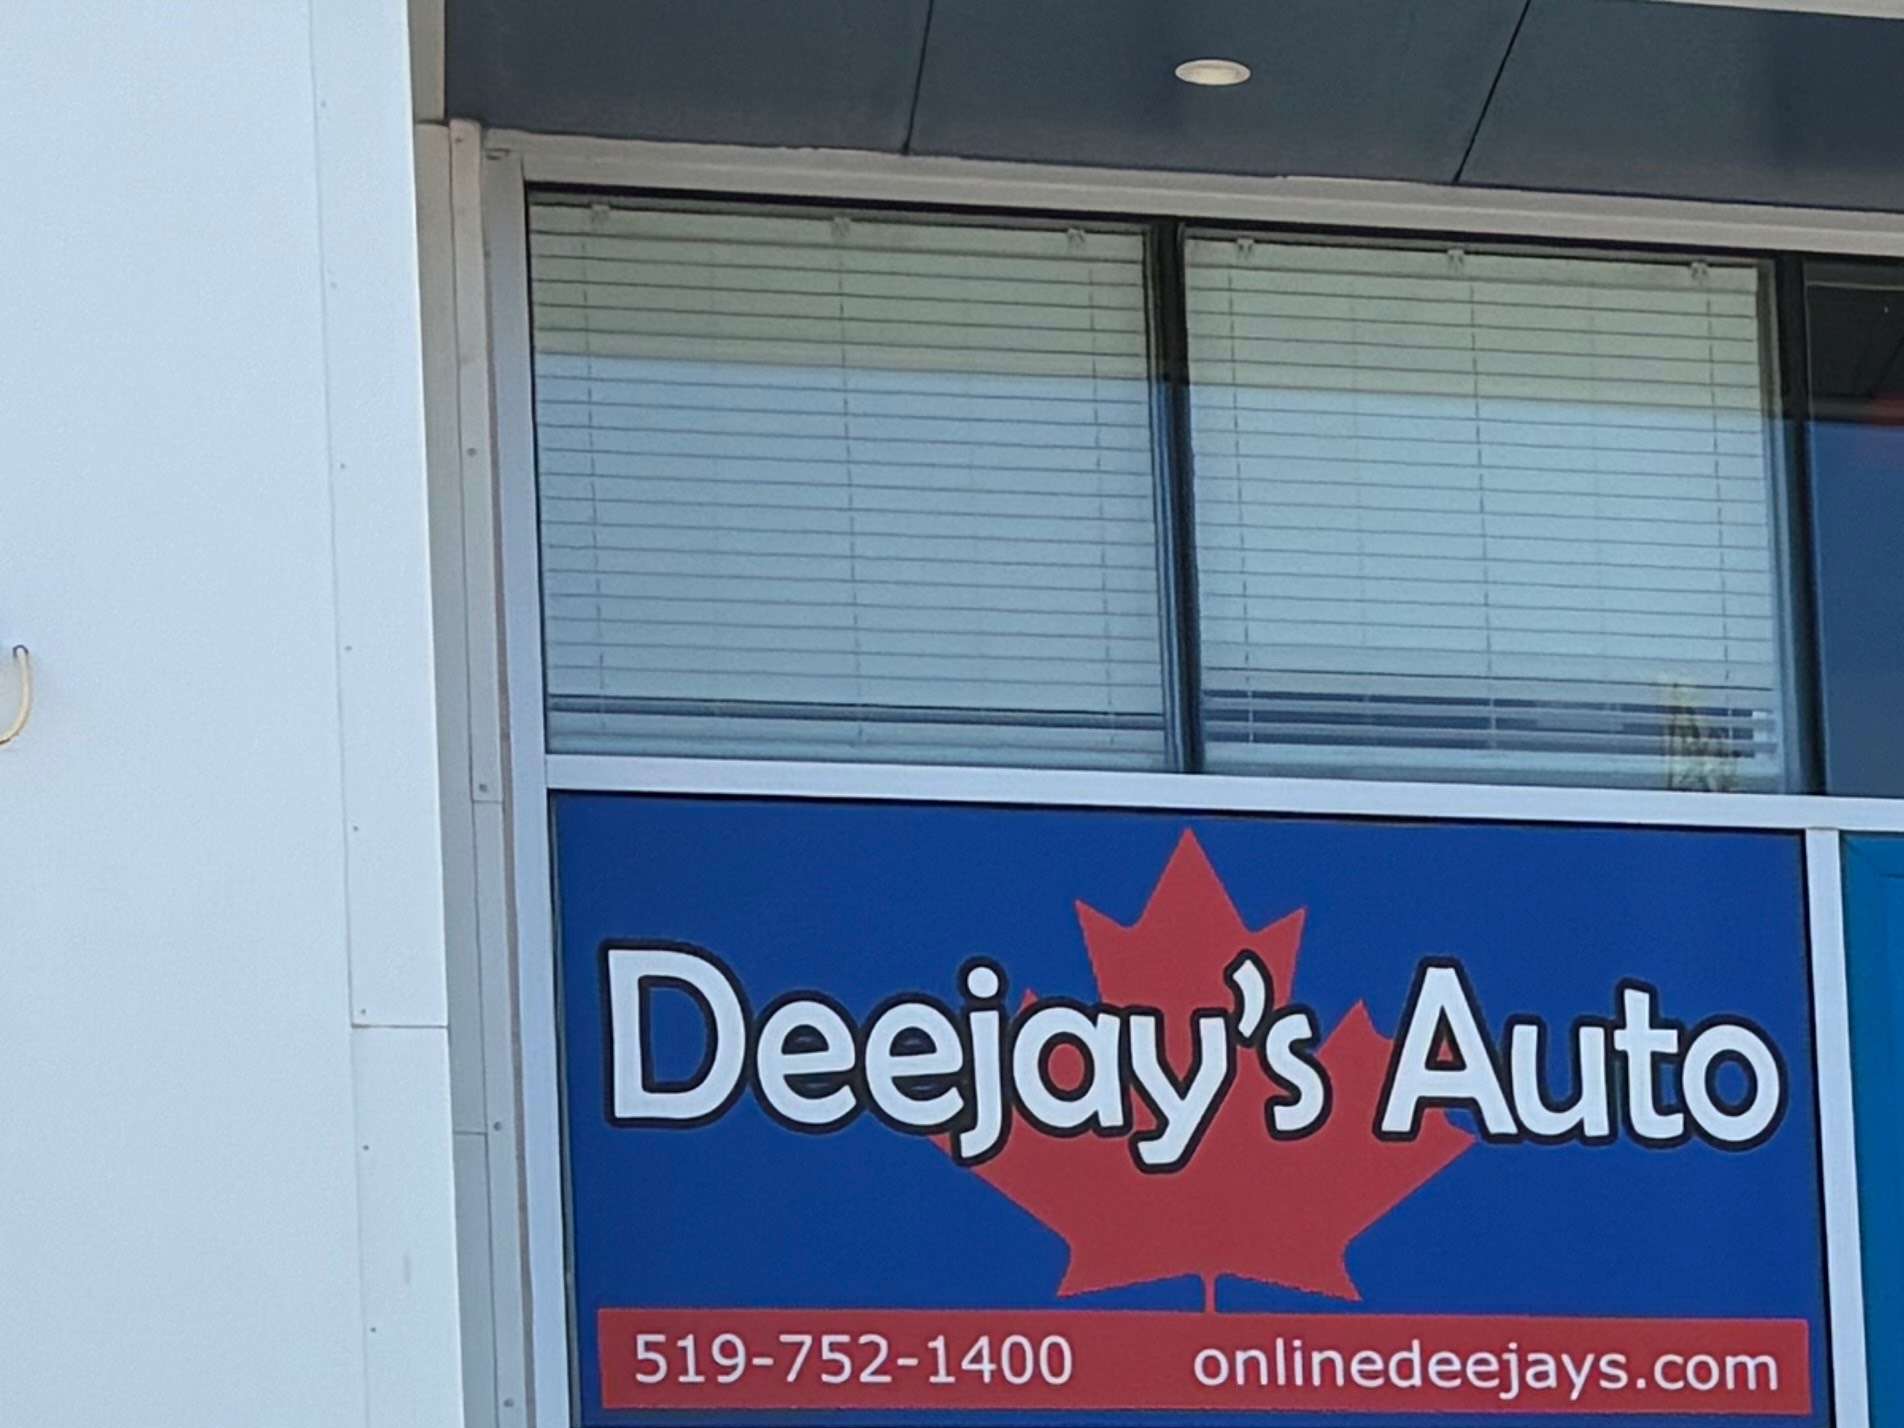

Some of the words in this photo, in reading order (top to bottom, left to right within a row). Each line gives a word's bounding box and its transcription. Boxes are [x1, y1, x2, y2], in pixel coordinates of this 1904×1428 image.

[602, 943, 1327, 1170] Deejay's
[1376, 960, 1786, 1149] Auto
[634, 1333, 1074, 1387] 519-752-1400
[1194, 1338, 1780, 1401] onlinedeejays.com
